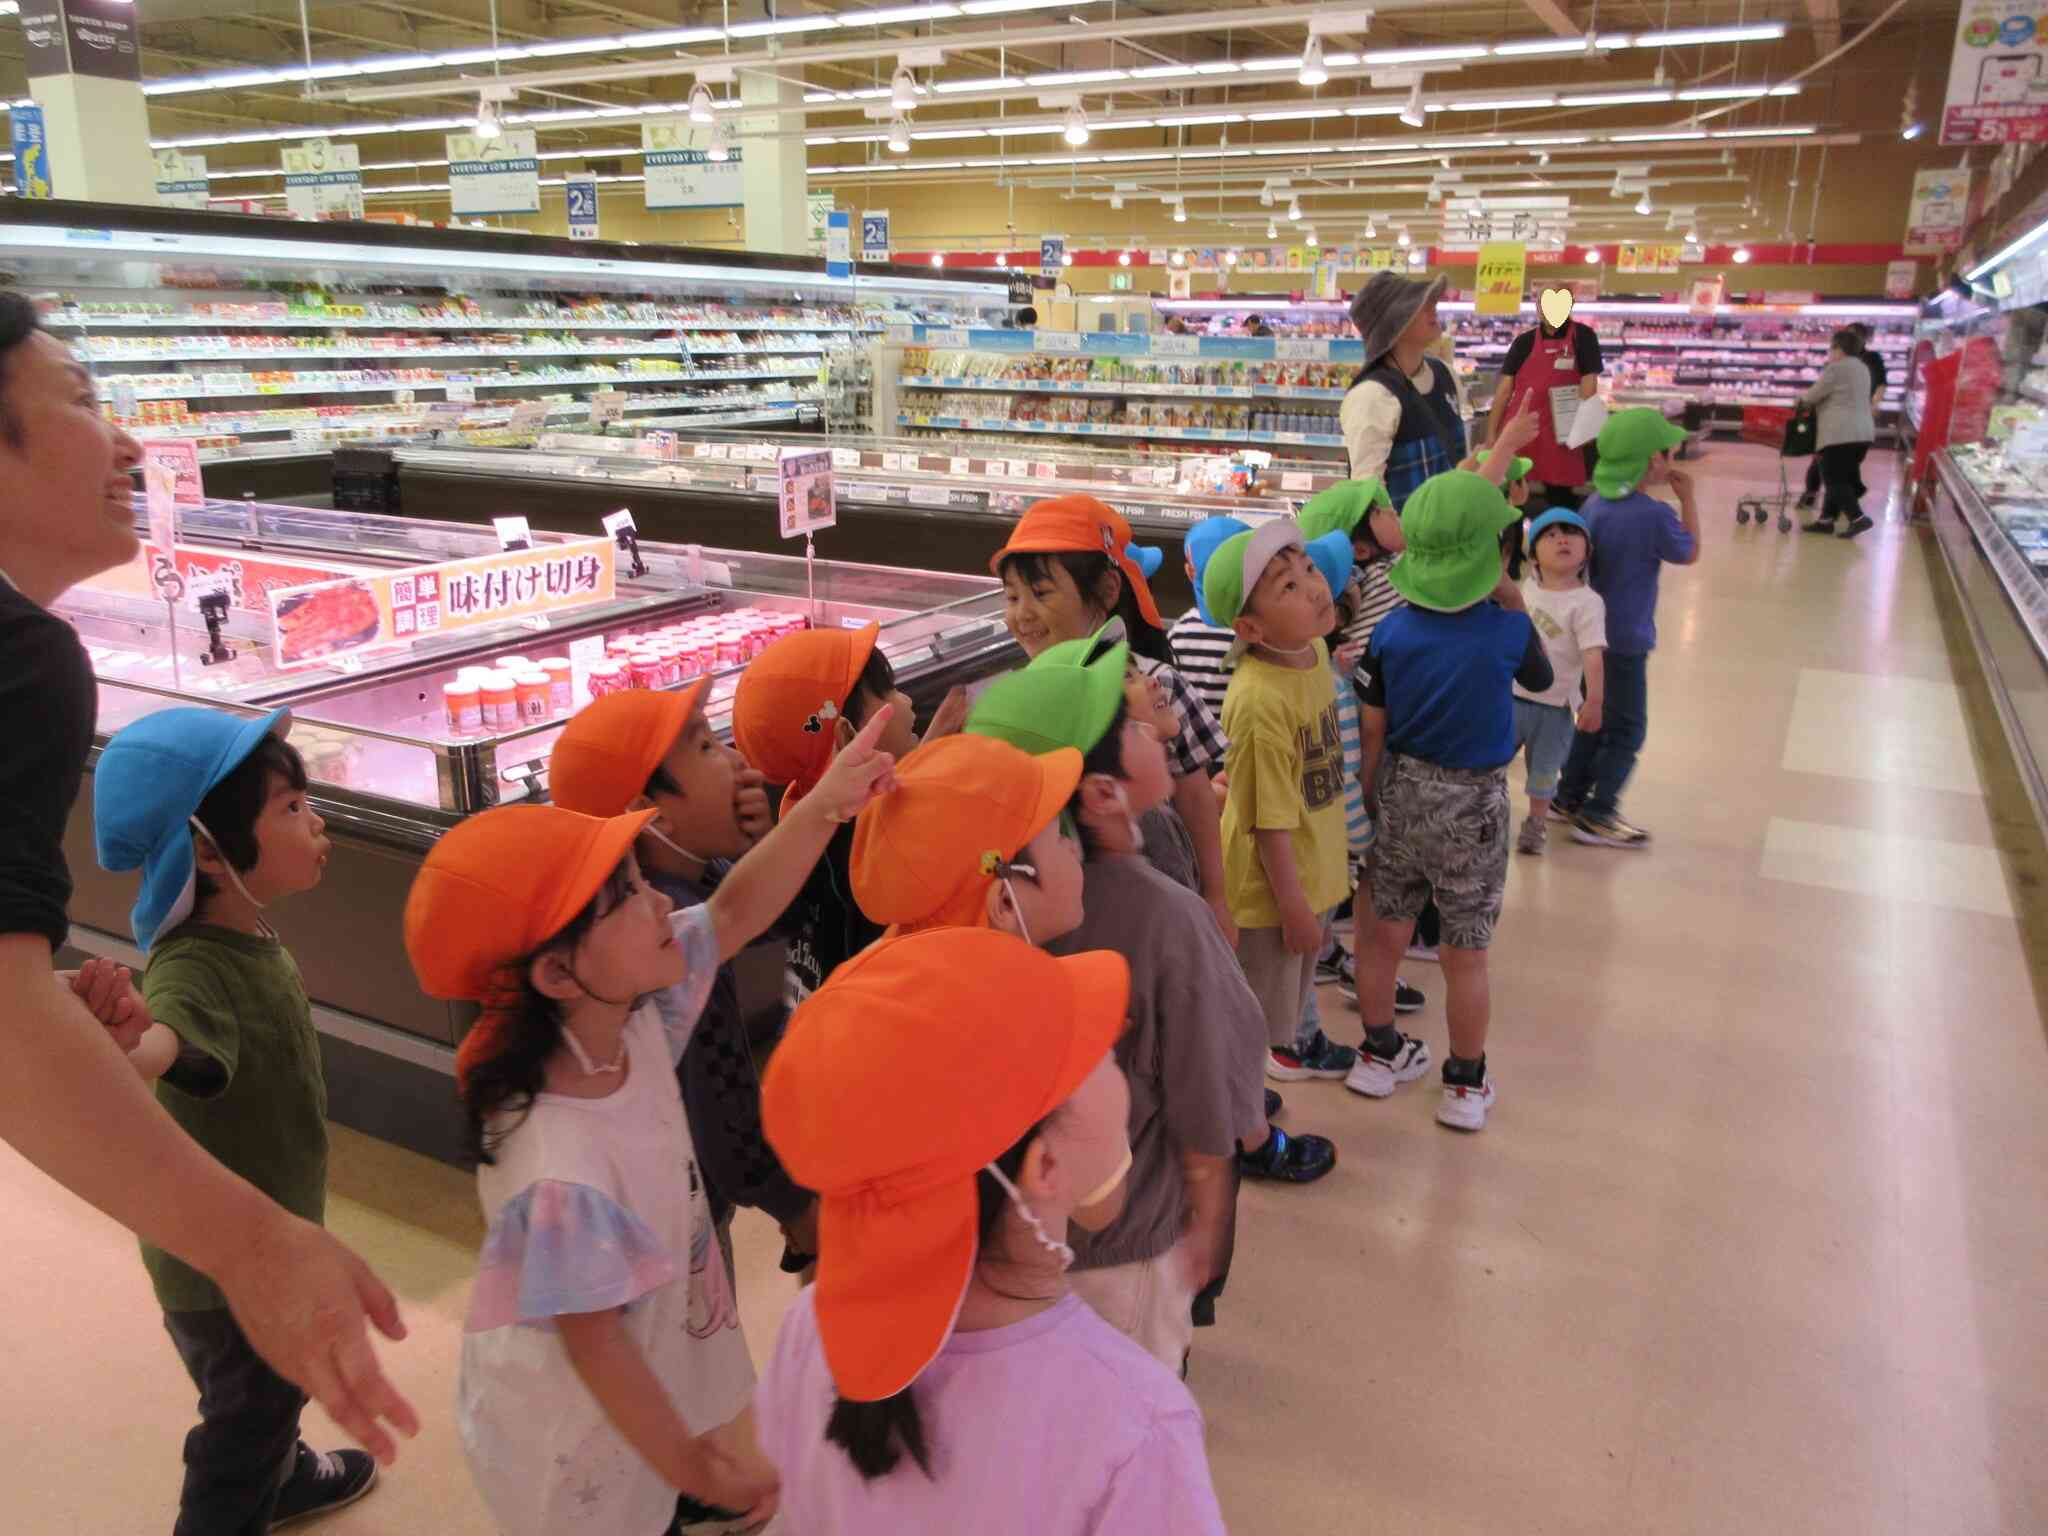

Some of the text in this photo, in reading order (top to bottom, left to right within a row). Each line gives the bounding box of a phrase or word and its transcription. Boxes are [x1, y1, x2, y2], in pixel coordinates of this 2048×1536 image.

[646, 152, 690, 165] EVERYDAY
[450, 163, 488, 175] EVERYDAY
[509, 161, 535, 171] PRICES
[450, 555, 601, 615] 味付け切身
